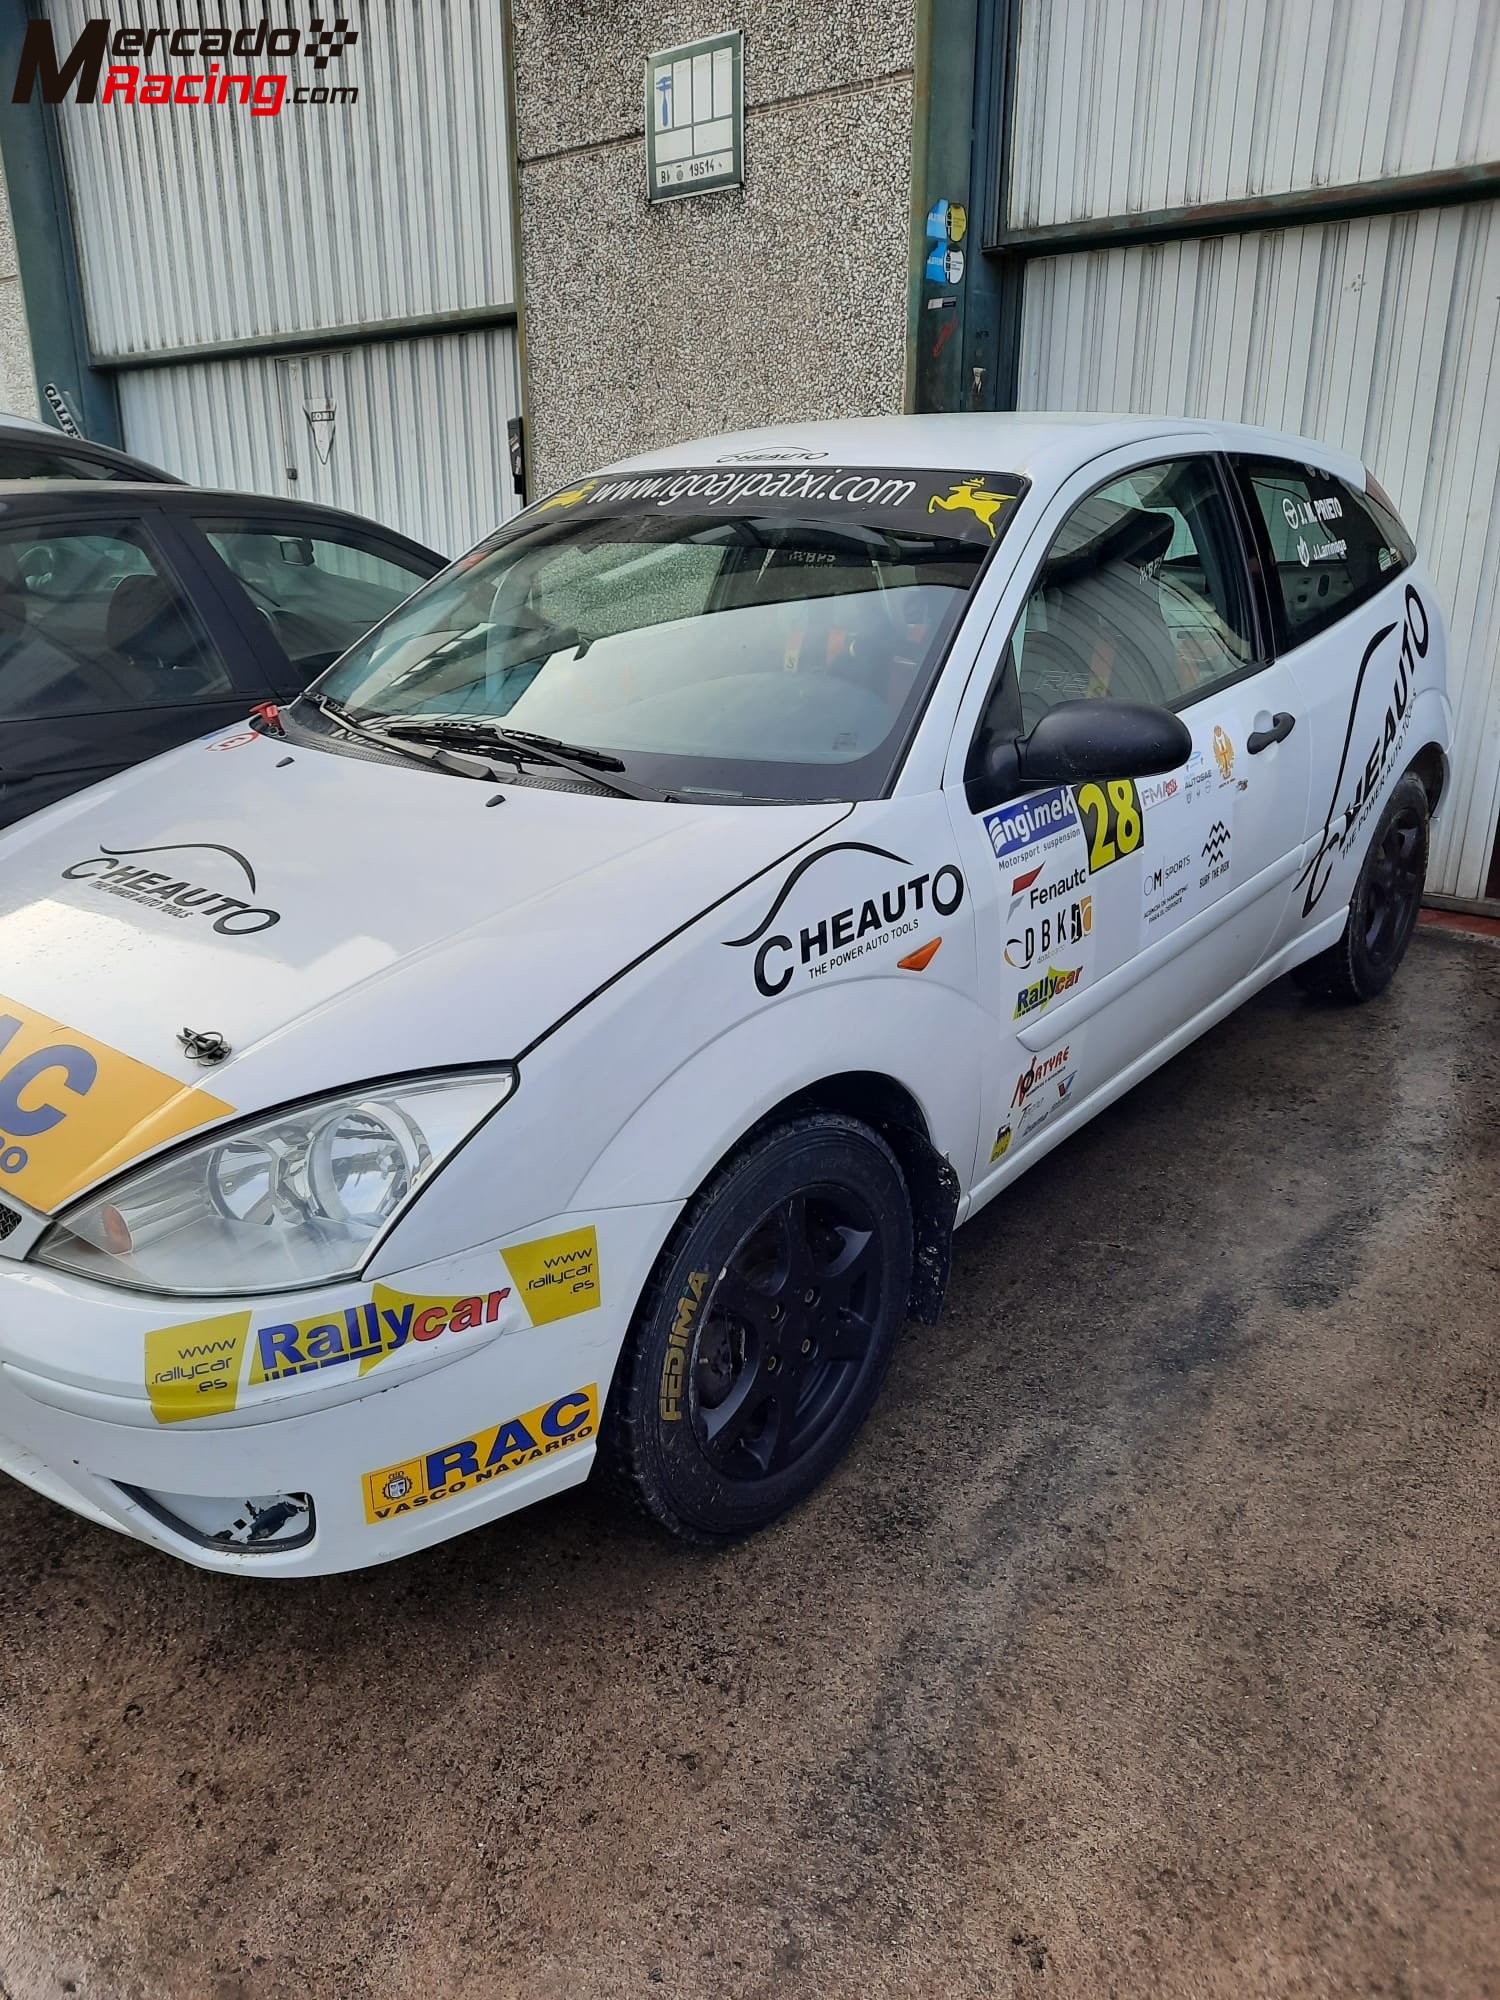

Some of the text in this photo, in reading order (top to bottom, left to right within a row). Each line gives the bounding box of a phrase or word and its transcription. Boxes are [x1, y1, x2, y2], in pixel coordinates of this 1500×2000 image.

[589, 469, 917, 508] www.igoaypatxi.com
[988, 788, 1075, 858] Engimek
[998, 828, 1081, 872] Motorsport suspension
[1078, 779, 1142, 873] 28
[61, 857, 281, 935] CHEAUTO
[1164, 854, 1191, 879] SPORTS
[754, 864, 964, 997] CHEAUTO
[808, 918, 919, 979] THE POWER AUTO TOOLS
[1017, 965, 1084, 1013] Rallycar
[543, 1247, 593, 1268] www
[178, 1337, 237, 1360] www
[257, 1286, 511, 1371] Rallycar
[660, 1271, 710, 1421] FEDIMA
[374, 1425, 593, 1519] VASCO NAVARRO
[425, 1392, 591, 1490] RAC
